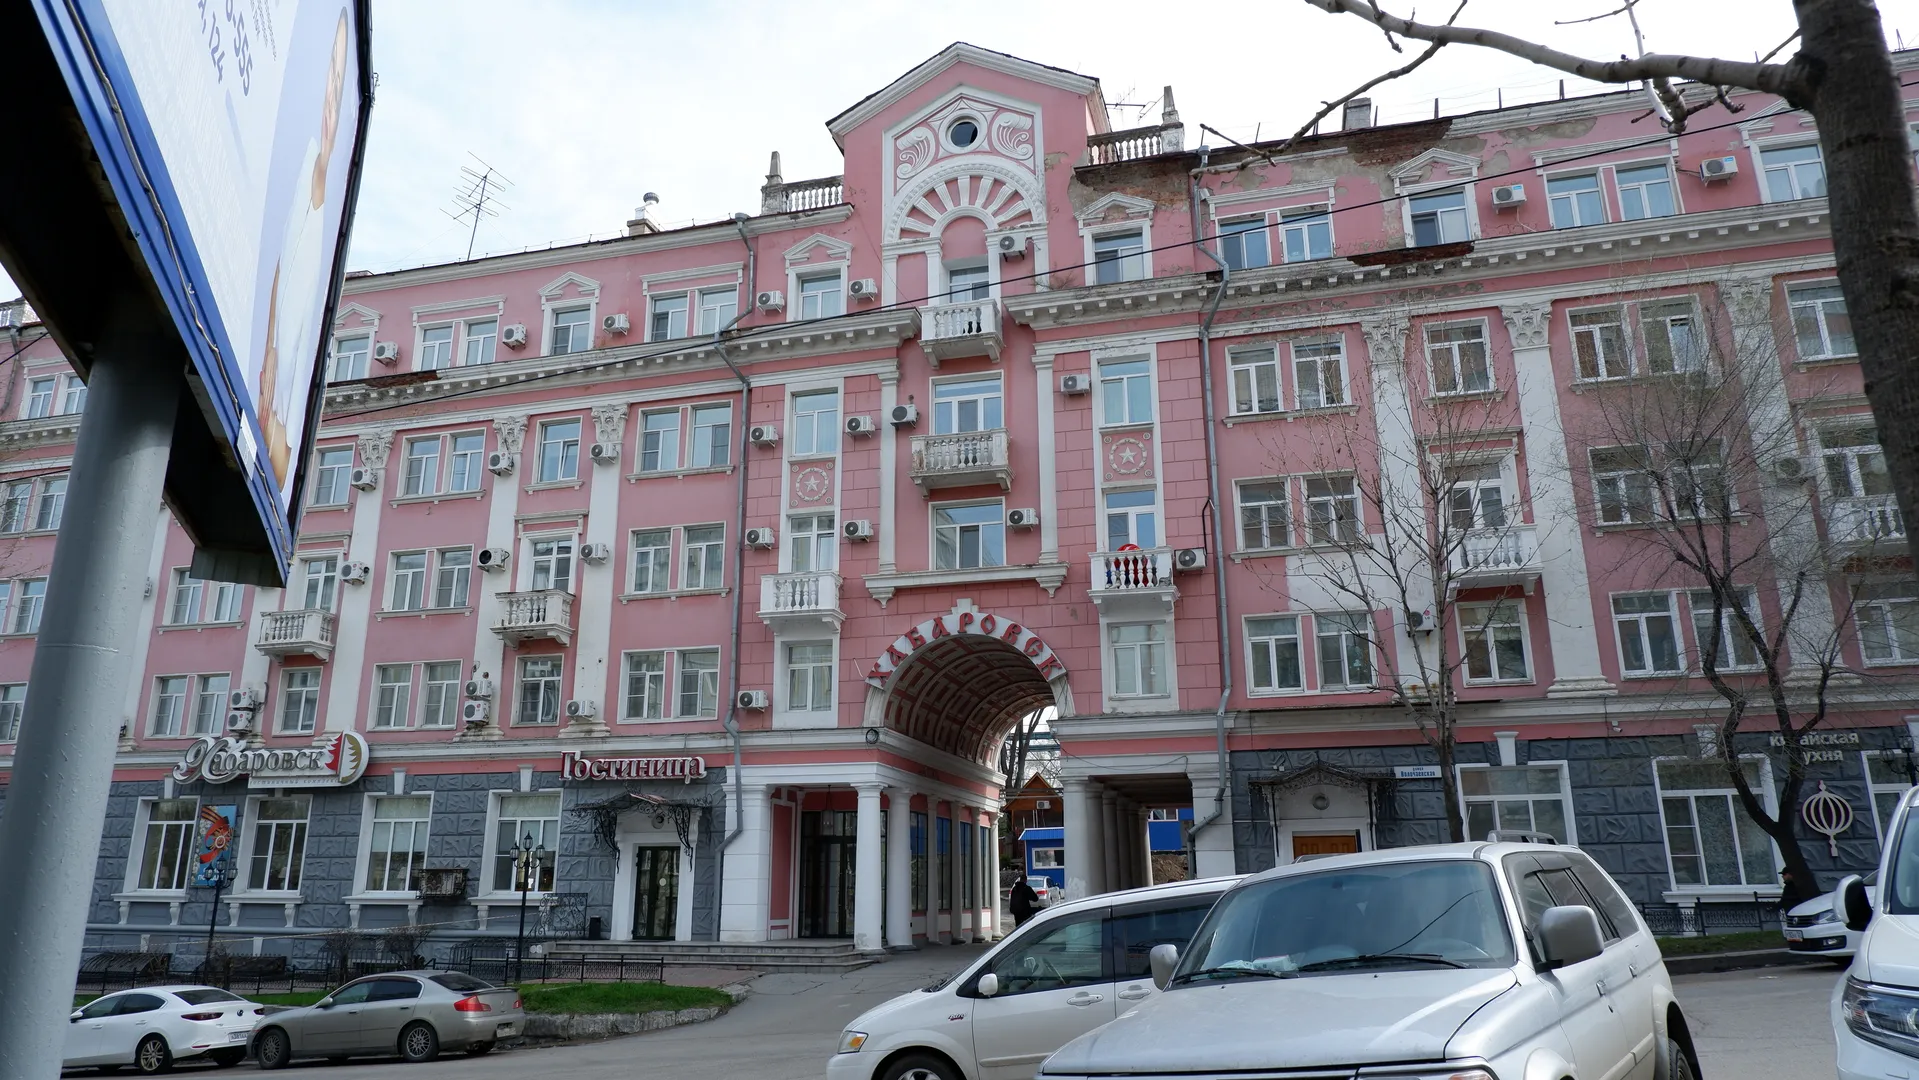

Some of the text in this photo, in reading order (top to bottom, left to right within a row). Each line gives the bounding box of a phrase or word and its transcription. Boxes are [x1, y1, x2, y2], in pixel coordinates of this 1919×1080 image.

[867, 612, 1062, 686] ХАБАРОВСК
[1769, 732, 1859, 746] киайская
[172, 737, 325, 784] Хабаровск
[559, 751, 707, 784] Гостиница
